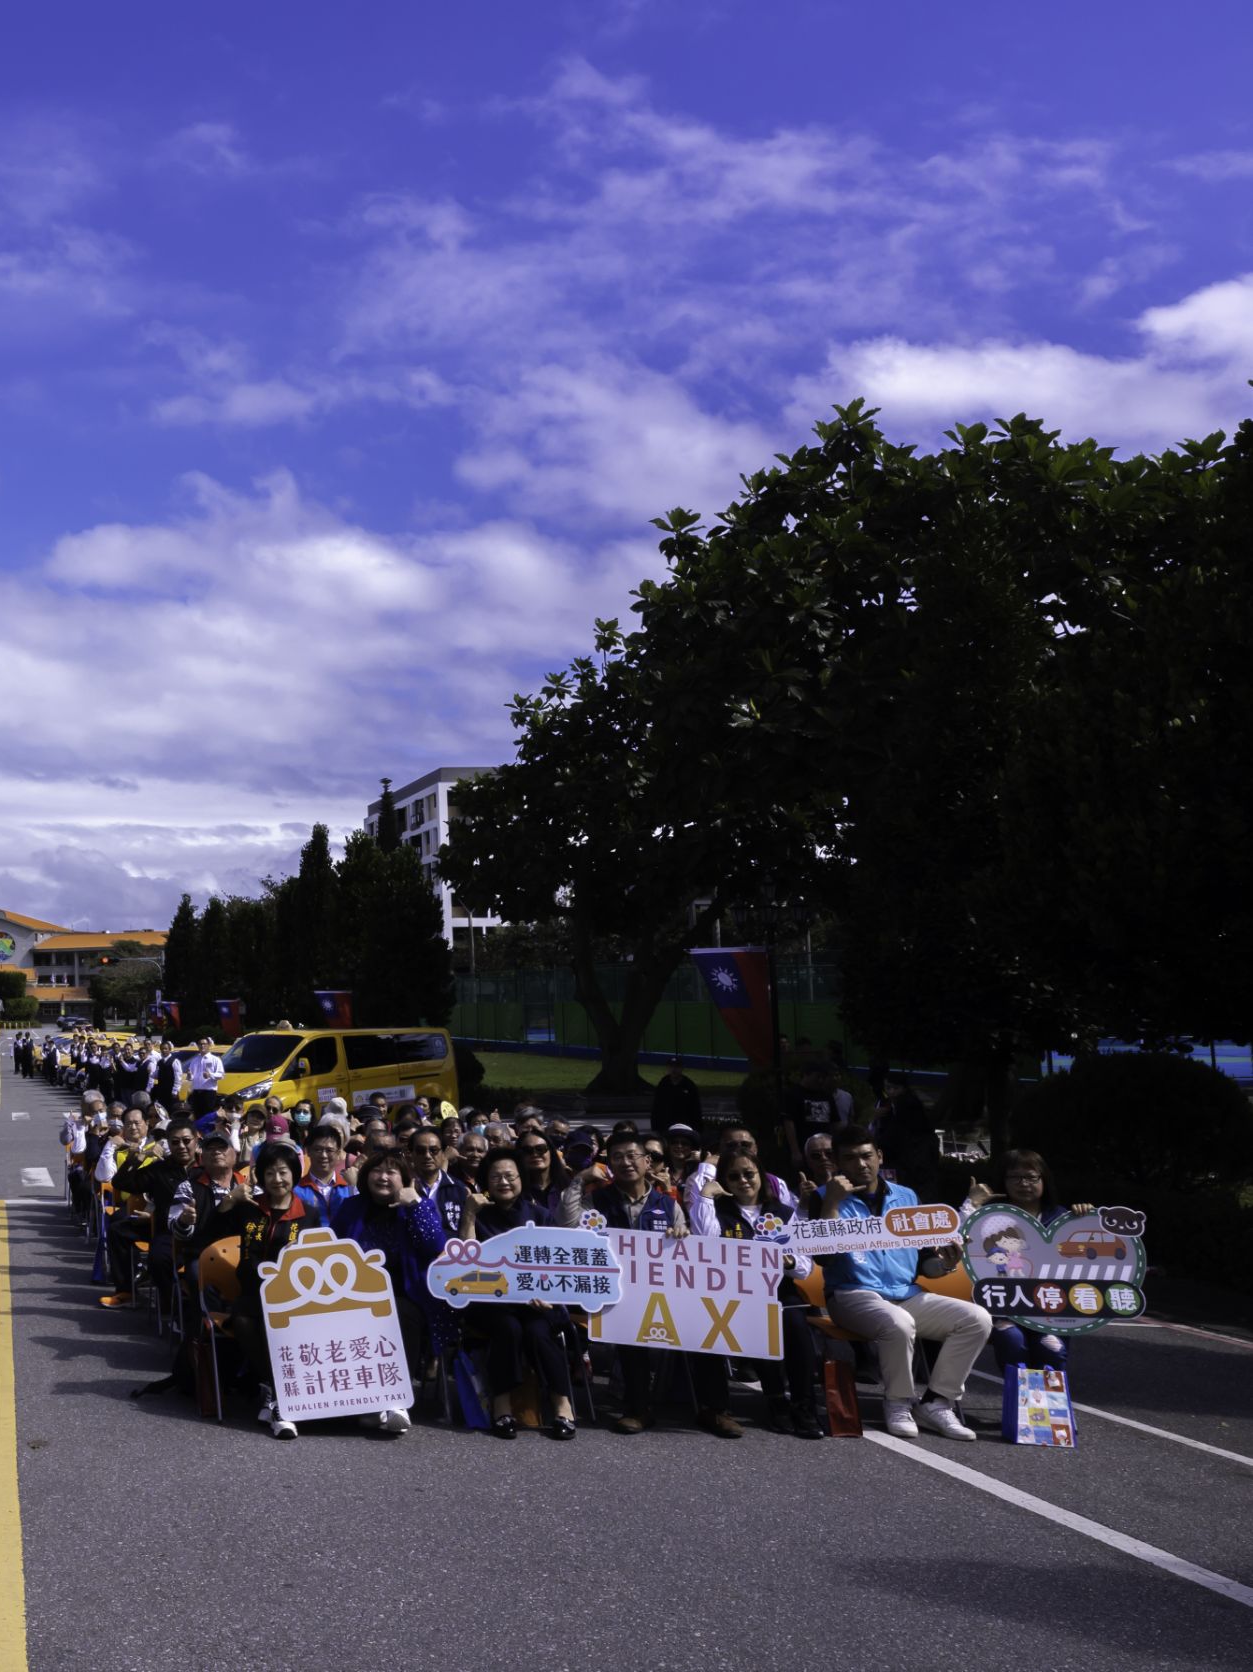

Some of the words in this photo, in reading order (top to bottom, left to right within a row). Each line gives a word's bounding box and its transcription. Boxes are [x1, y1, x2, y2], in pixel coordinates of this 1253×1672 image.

[791, 1217, 883, 1240] 花蓮縣政府
[890, 1210, 953, 1233] 社會處
[515, 1246, 609, 1267] 運轉全覆蓋
[619, 1235, 779, 1269] HUALIEN
[798, 1245, 835, 1254] Hualien
[837, 1241, 867, 1251] Social
[869, 1239, 900, 1250] Affairs
[904, 1235, 961, 1247] Department
[516, 1272, 610, 1294] 愛心不漏接
[630, 1260, 780, 1297] IENDLY
[981, 1284, 1137, 1312] 行人停看聽
[298, 1335, 397, 1367] 敬老愛心
[278, 1345, 301, 1398] 花蓮縣
[302, 1361, 403, 1396] 計程車隊
[287, 1401, 330, 1413] HUALIEN
[333, 1396, 380, 1408] FRIENDLY
[384, 1393, 406, 1402] TAXI
